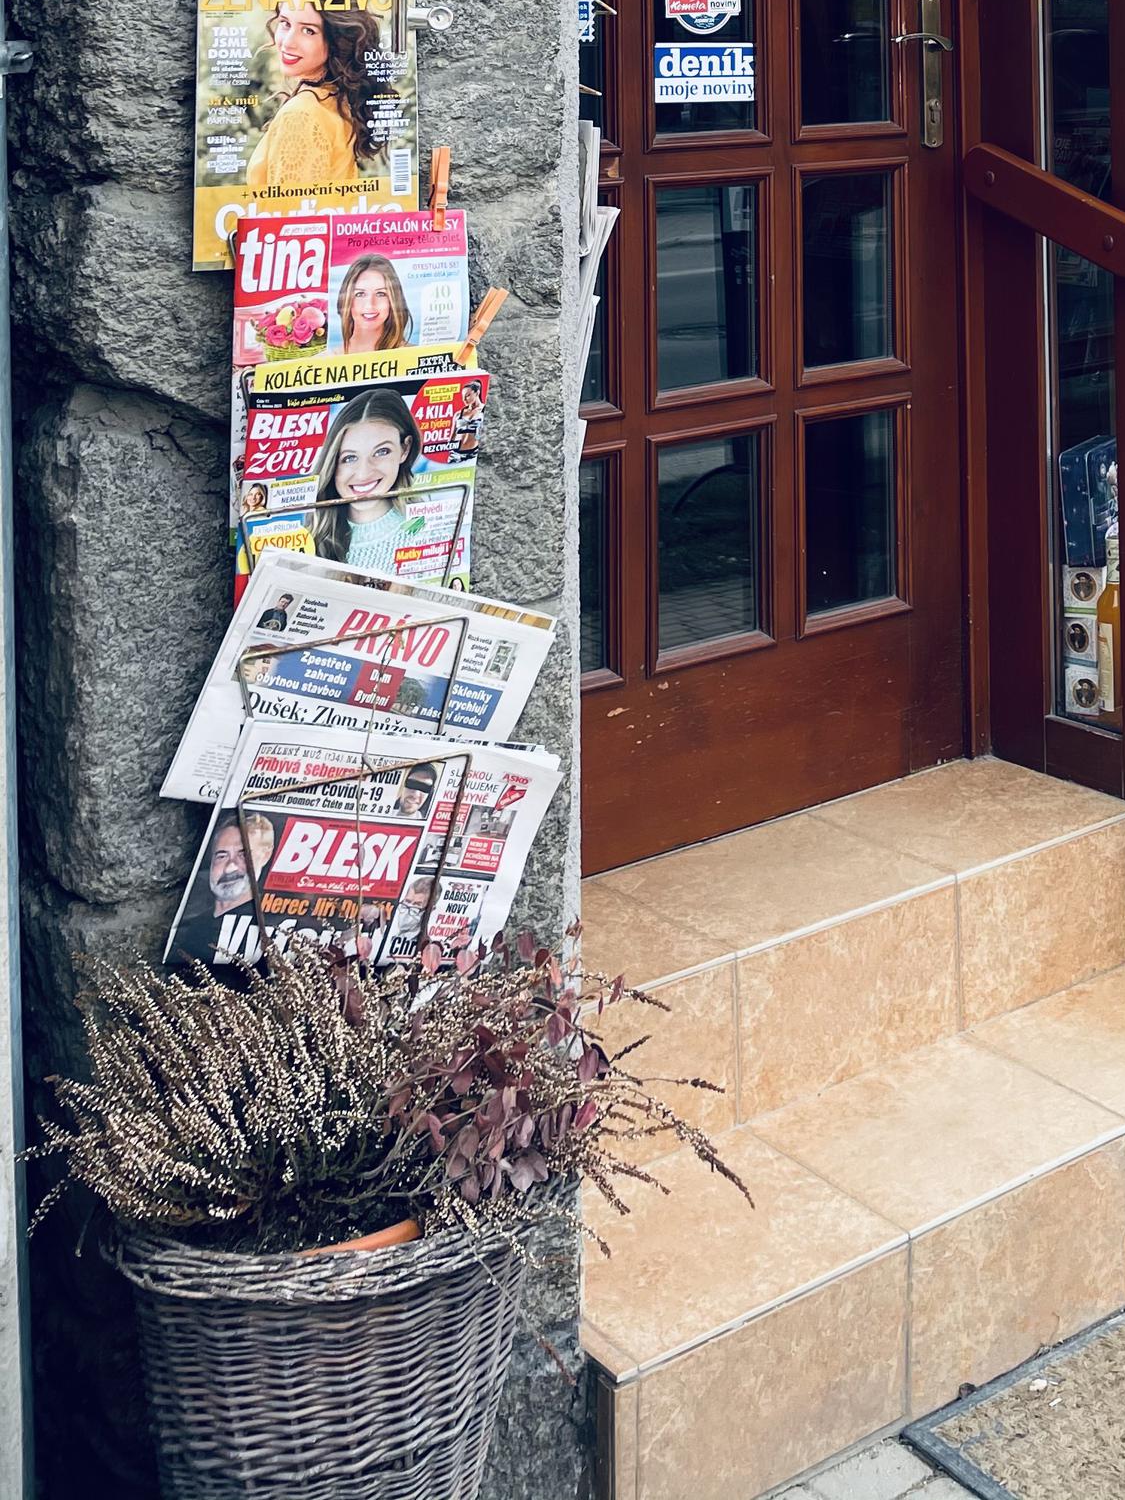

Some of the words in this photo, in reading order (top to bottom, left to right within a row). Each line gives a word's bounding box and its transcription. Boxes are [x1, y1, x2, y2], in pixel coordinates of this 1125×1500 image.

[710, 0, 738, 10] noviny
[211, 26, 248, 37] TADY
[211, 37, 248, 48] JSME
[208, 48, 252, 59] DOMA
[659, 47, 754, 77] deník
[659, 80, 699, 100] moje
[703, 80, 754, 98] noviny
[252, 182, 333, 200] velikonoční
[335, 179, 380, 195] speciál
[336, 219, 381, 236] DOMÁCÍ
[382, 217, 418, 233] SALÓN
[421, 217, 459, 232] KRSY
[347, 237, 362, 247] Pro
[363, 235, 390, 249] pěkné
[391, 234, 416, 247] vlasy,
[239, 226, 328, 294] tina
[418, 355, 451, 367] EXTRA
[264, 362, 322, 391] KOLÁČE
[326, 365, 348, 383] NA
[352, 360, 399, 382] PLECH
[415, 409, 424, 420] 4
[425, 404, 454, 420] KILA
[250, 410, 329, 440] BLESK
[420, 421, 429, 430] za
[430, 418, 451, 431] týden
[278, 438, 299, 451] pro
[423, 431, 450, 443] DOLE
[423, 444, 434, 453] BEZ
[246, 442, 323, 476] ženy
[254, 529, 309, 553] ČASOPISY
[331, 608, 450, 669] PRÁVO
[300, 650, 352, 673] Zpestřete
[255, 671, 300, 691] obytnou
[300, 682, 342, 699] stavbou
[304, 666, 348, 686] zahradu
[353, 688, 389, 708] Bydlení
[450, 683, 494, 703] Skleníky
[308, 705, 358, 729] Zlom
[452, 710, 482, 727] úrodu
[259, 744, 301, 757] UPÁLENÝ
[302, 746, 323, 759] MUŽ
[345, 755, 358, 764] NA
[253, 756, 300, 775] Přibývá
[502, 773, 529, 786] ASKO
[286, 793, 320, 808] pomoc?
[344, 802, 355, 811] na
[369, 804, 377, 813] 2
[385, 805, 391, 814] 3
[271, 821, 416, 885] BLESK
[260, 891, 310, 917] Herec
[311, 894, 339, 918] Jiří
[445, 900, 468, 915] NOVÝ
